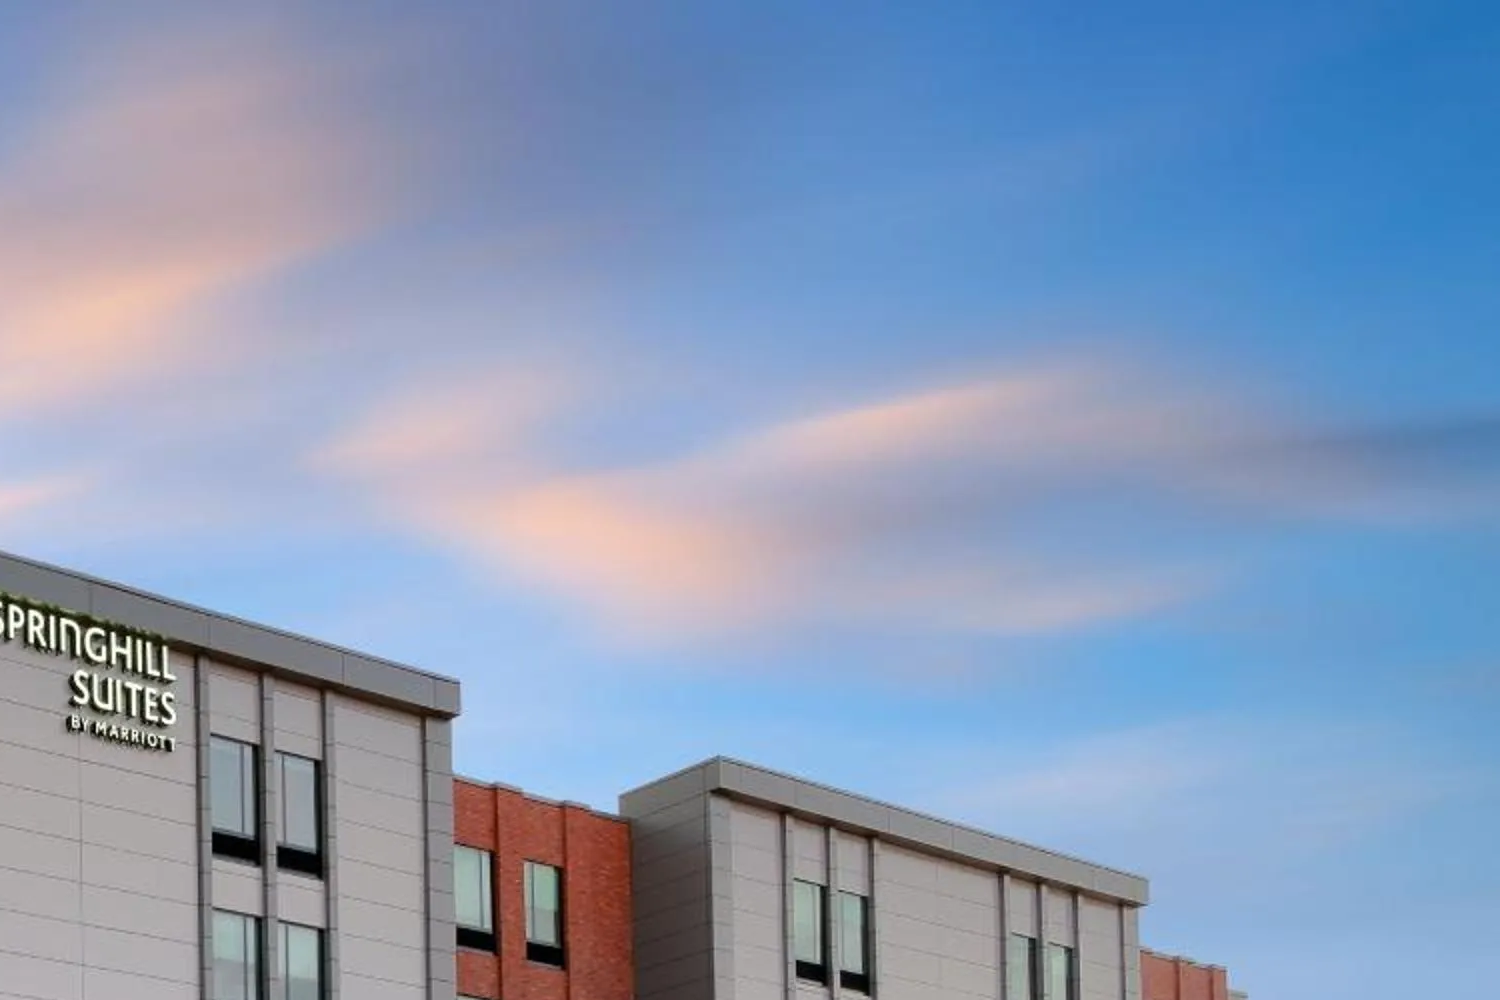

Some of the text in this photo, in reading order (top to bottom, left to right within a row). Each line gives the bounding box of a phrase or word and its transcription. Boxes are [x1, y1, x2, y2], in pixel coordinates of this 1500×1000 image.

[72, 669, 177, 725] SUITES
[70, 714, 176, 751] BY MARRIOTT
